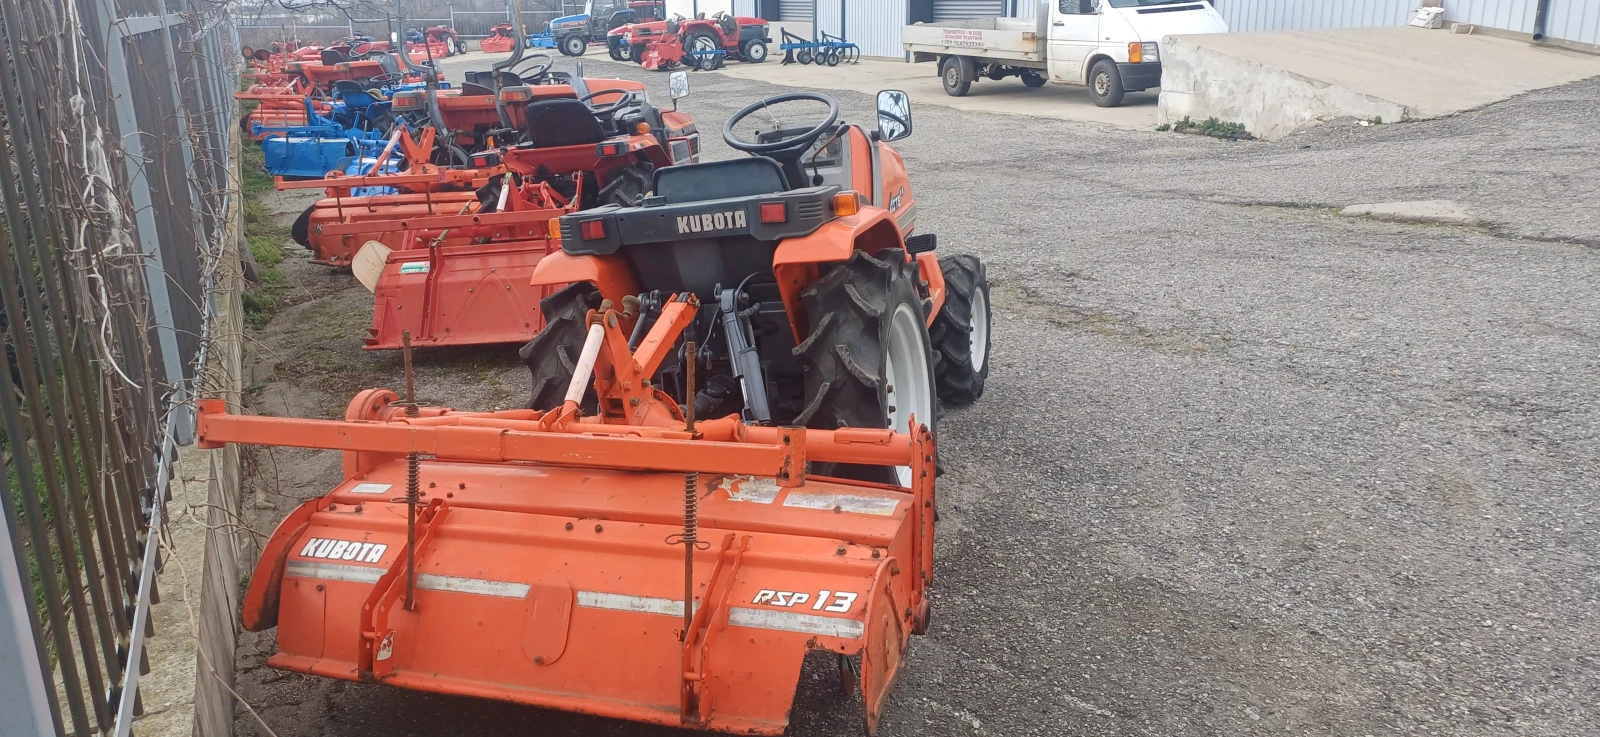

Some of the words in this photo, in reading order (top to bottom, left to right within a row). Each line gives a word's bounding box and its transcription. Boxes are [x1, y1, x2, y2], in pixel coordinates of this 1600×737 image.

[676, 209, 747, 234] KUBOTA
[299, 537, 388, 563] KUBOTA
[752, 590, 810, 607] RSP
[811, 590, 858, 613] 13
